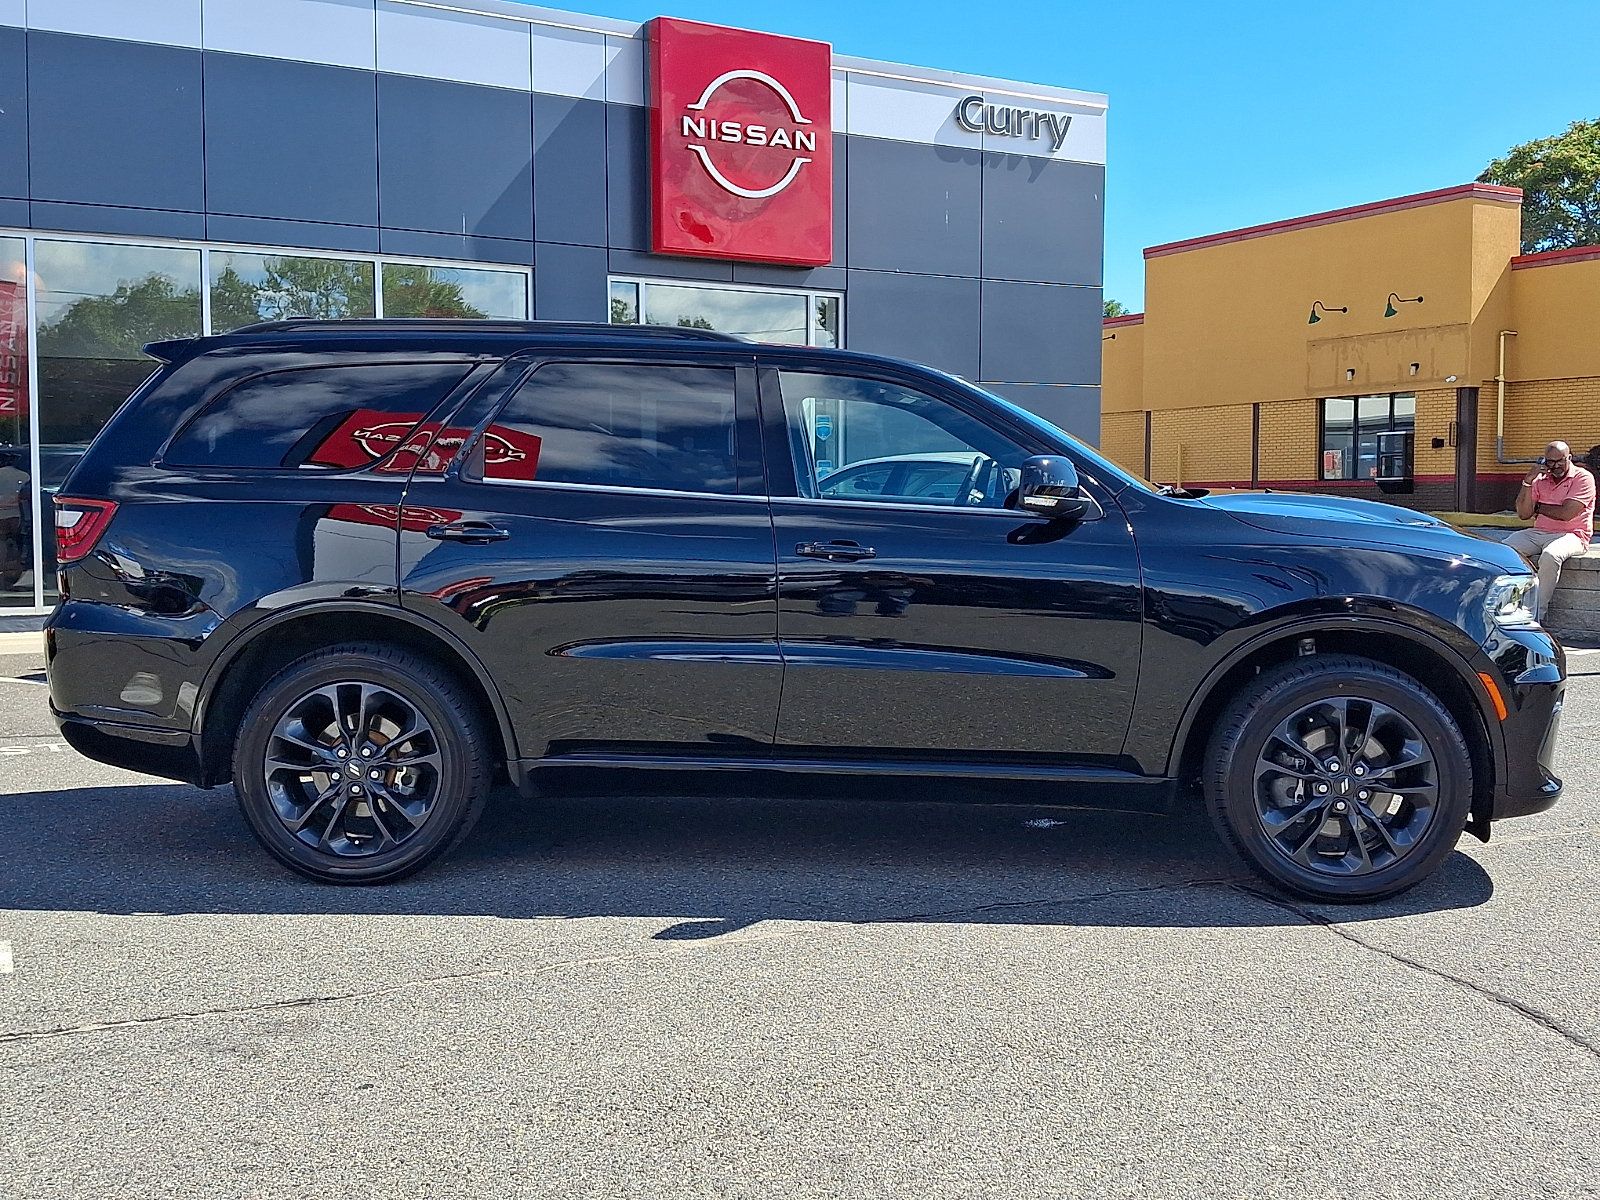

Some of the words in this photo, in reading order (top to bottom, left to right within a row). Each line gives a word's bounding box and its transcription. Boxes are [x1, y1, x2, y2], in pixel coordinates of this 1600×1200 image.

[682, 115, 816, 152] NISSAN
[957, 94, 1073, 152] Curry
[0, 320, 17, 411] NISSAN
